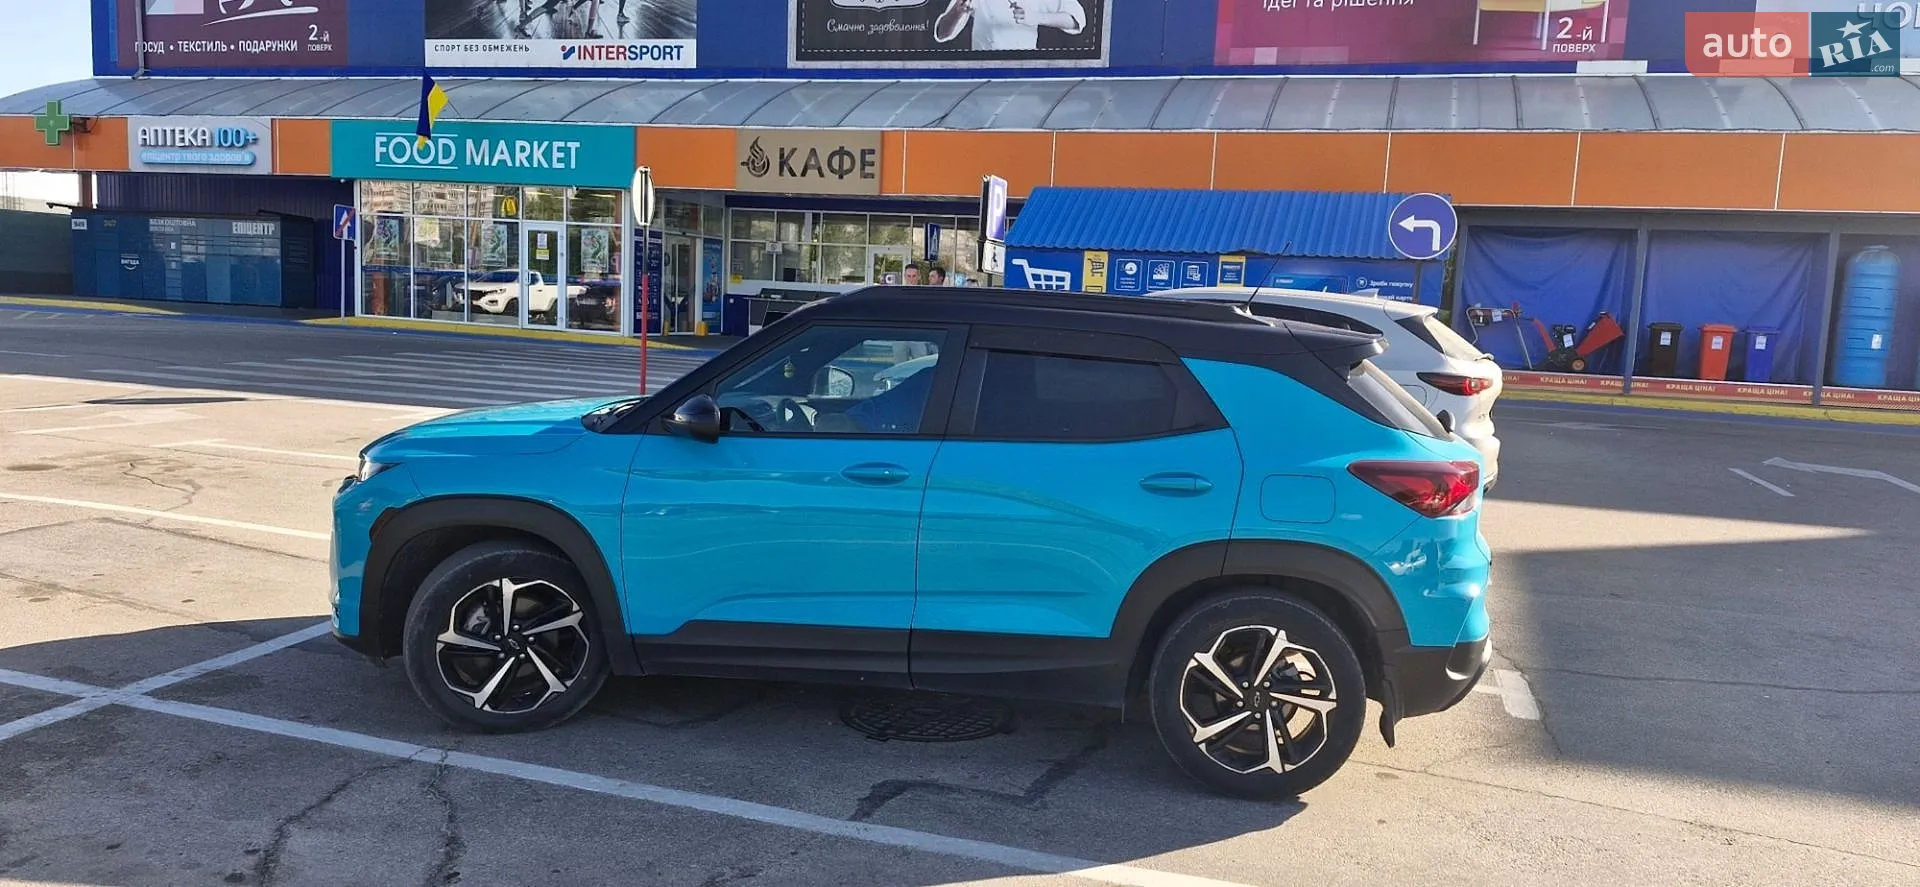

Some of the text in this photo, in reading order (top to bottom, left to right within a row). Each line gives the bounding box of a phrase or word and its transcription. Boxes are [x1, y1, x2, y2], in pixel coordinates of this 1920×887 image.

[177, 41, 227, 52] ТЕКСТИЛЬ
[239, 40, 298, 53] ПОДАРУНКИ
[434, 44, 461, 52] СПОРТ
[482, 44, 530, 52] ОБМЕЖЕНЬ
[577, 44, 684, 61] INTERSPORT
[1553, 43, 1596, 52] ПОВЕРХ
[138, 126, 258, 148] АПТЕКА 100+
[375, 136, 580, 169] FOOD MARKET
[778, 146, 876, 180] КАФЕ
[1665, 383, 1716, 393] КРАЩА ЦІНА!
[1737, 387, 1788, 397] КРАЩА ЦІНА!
